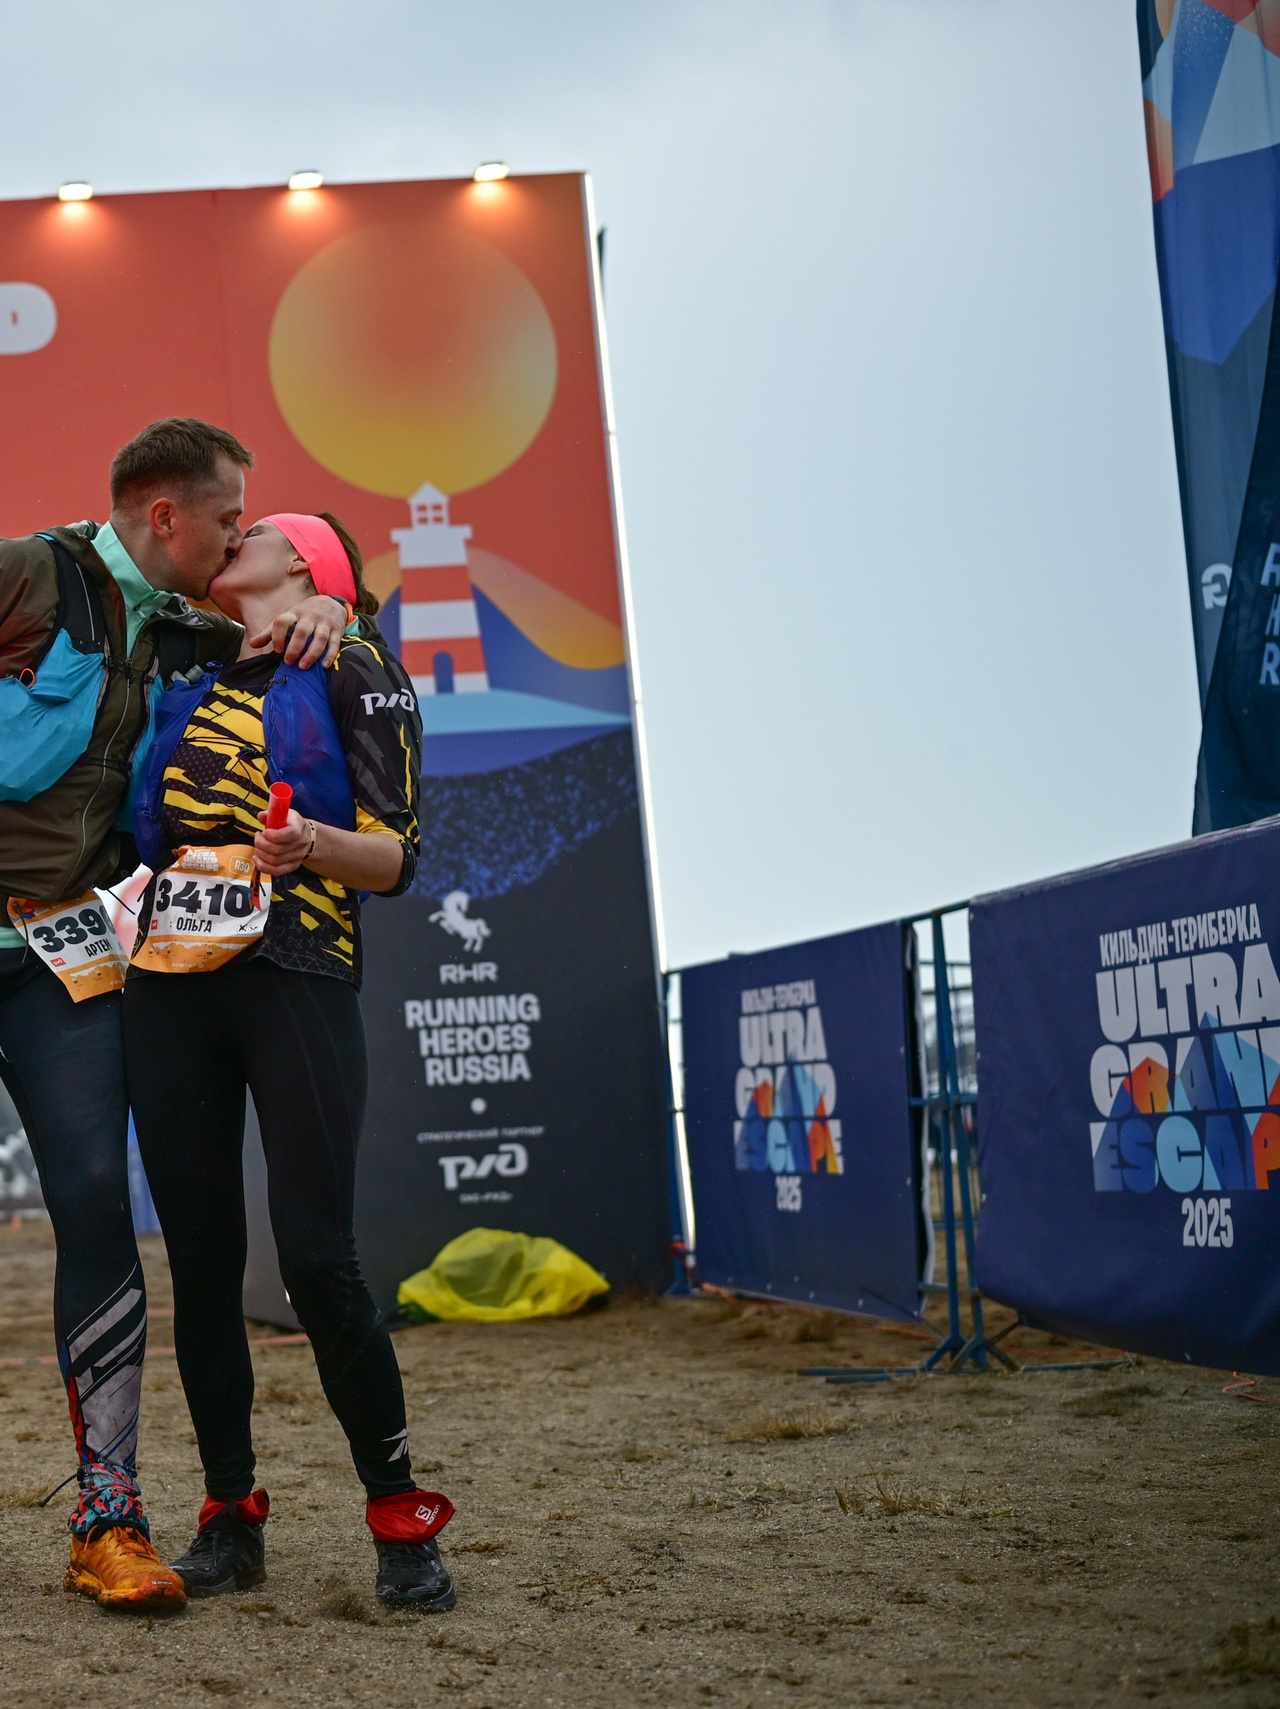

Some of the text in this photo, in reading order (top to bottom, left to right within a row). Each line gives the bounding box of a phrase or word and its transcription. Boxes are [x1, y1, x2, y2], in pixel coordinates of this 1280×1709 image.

[234, 860, 250, 872] R30
[156, 879, 255, 918] 3410
[176, 917, 212, 933] ОЛЬГА
[1099, 903, 1261, 968] КИЛЬДИН-ТЕРИБЕРКА
[439, 962, 498, 984] RHR
[405, 993, 541, 1030] RUNNING
[1095, 943, 1280, 1043] ULTRA
[419, 1023, 531, 1057] HEROES
[739, 1006, 827, 1067] ULTRA
[425, 1053, 531, 1087] RUSSIA
[1089, 1112, 1280, 1193] ESCAP
[1181, 1198, 1234, 1248] 2025
